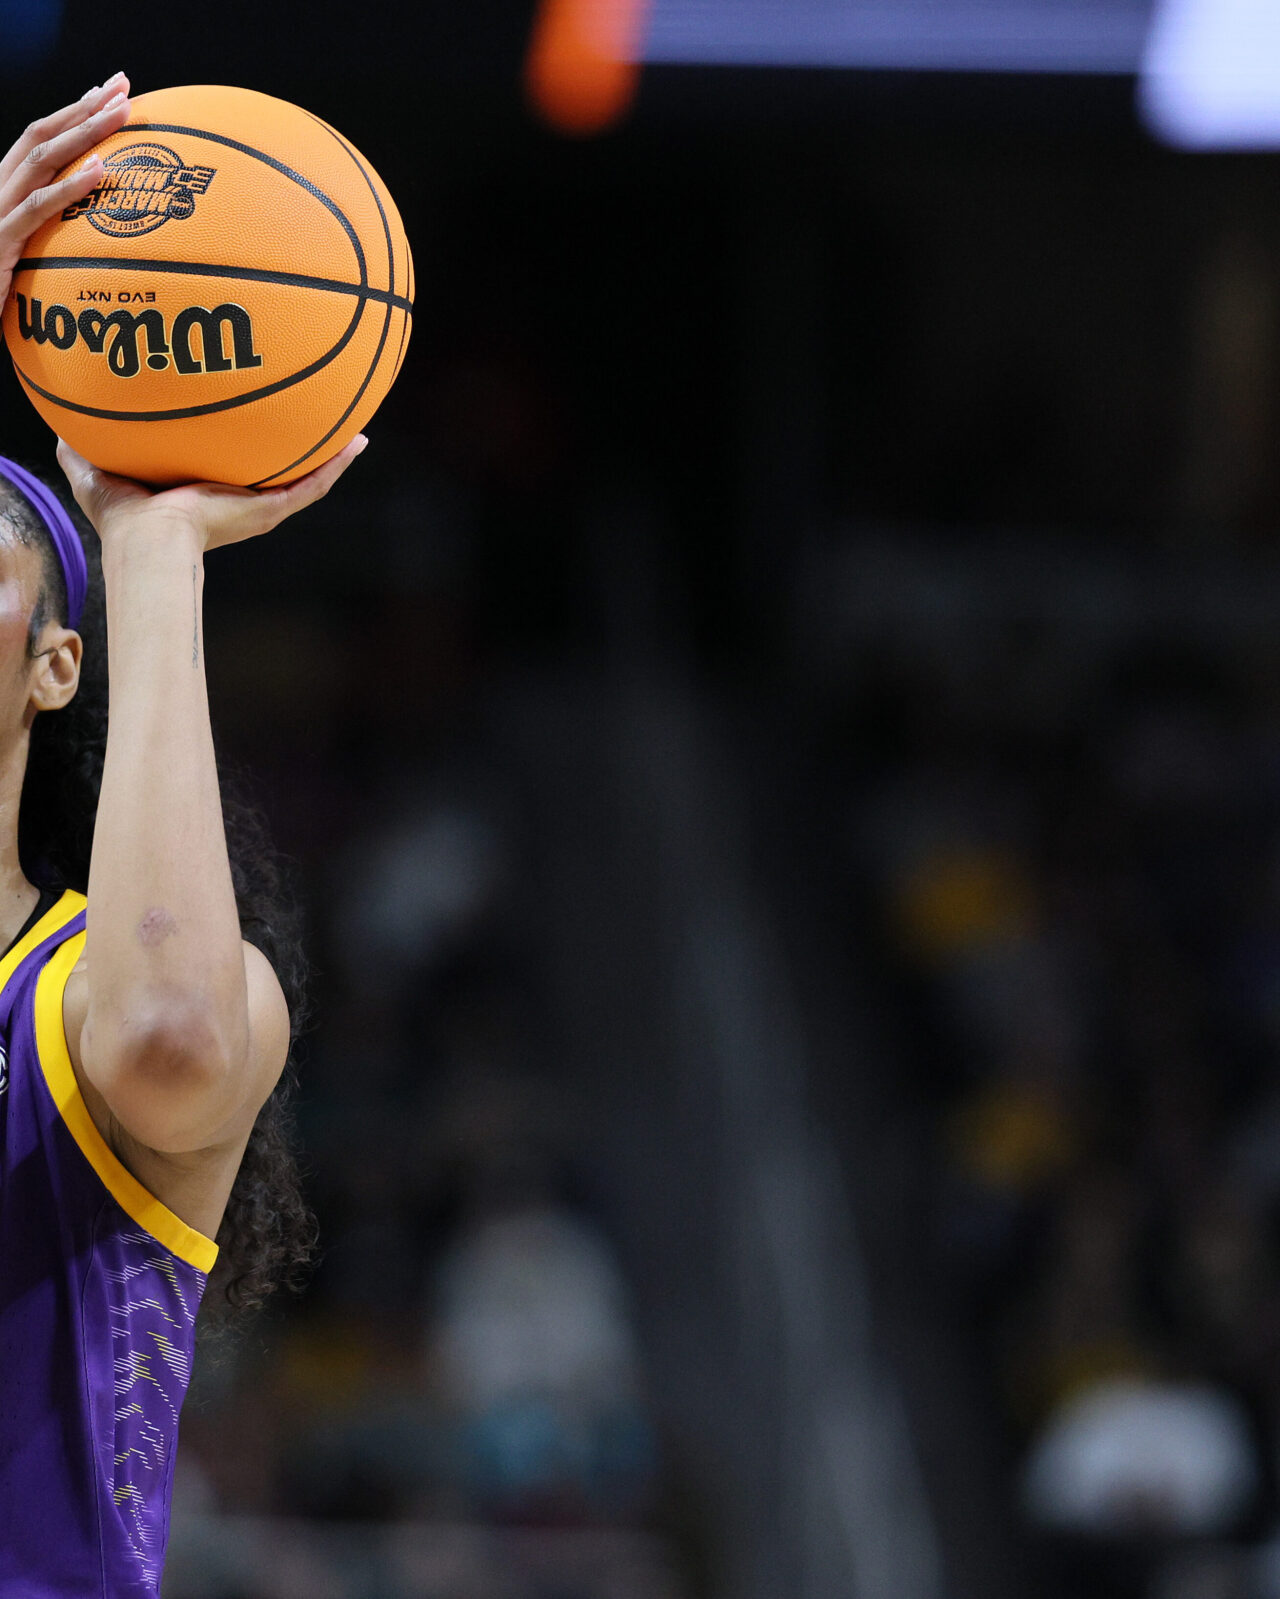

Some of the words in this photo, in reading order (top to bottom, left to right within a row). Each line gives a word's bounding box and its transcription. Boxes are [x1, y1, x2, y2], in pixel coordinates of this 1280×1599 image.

[96, 170, 169, 190] MADN
[95, 190, 172, 213] MARCH
[119, 220, 145, 231] SWEET
[76, 290, 112, 303] NXT
[118, 292, 156, 303] EVO
[18, 293, 262, 378] Wilson
